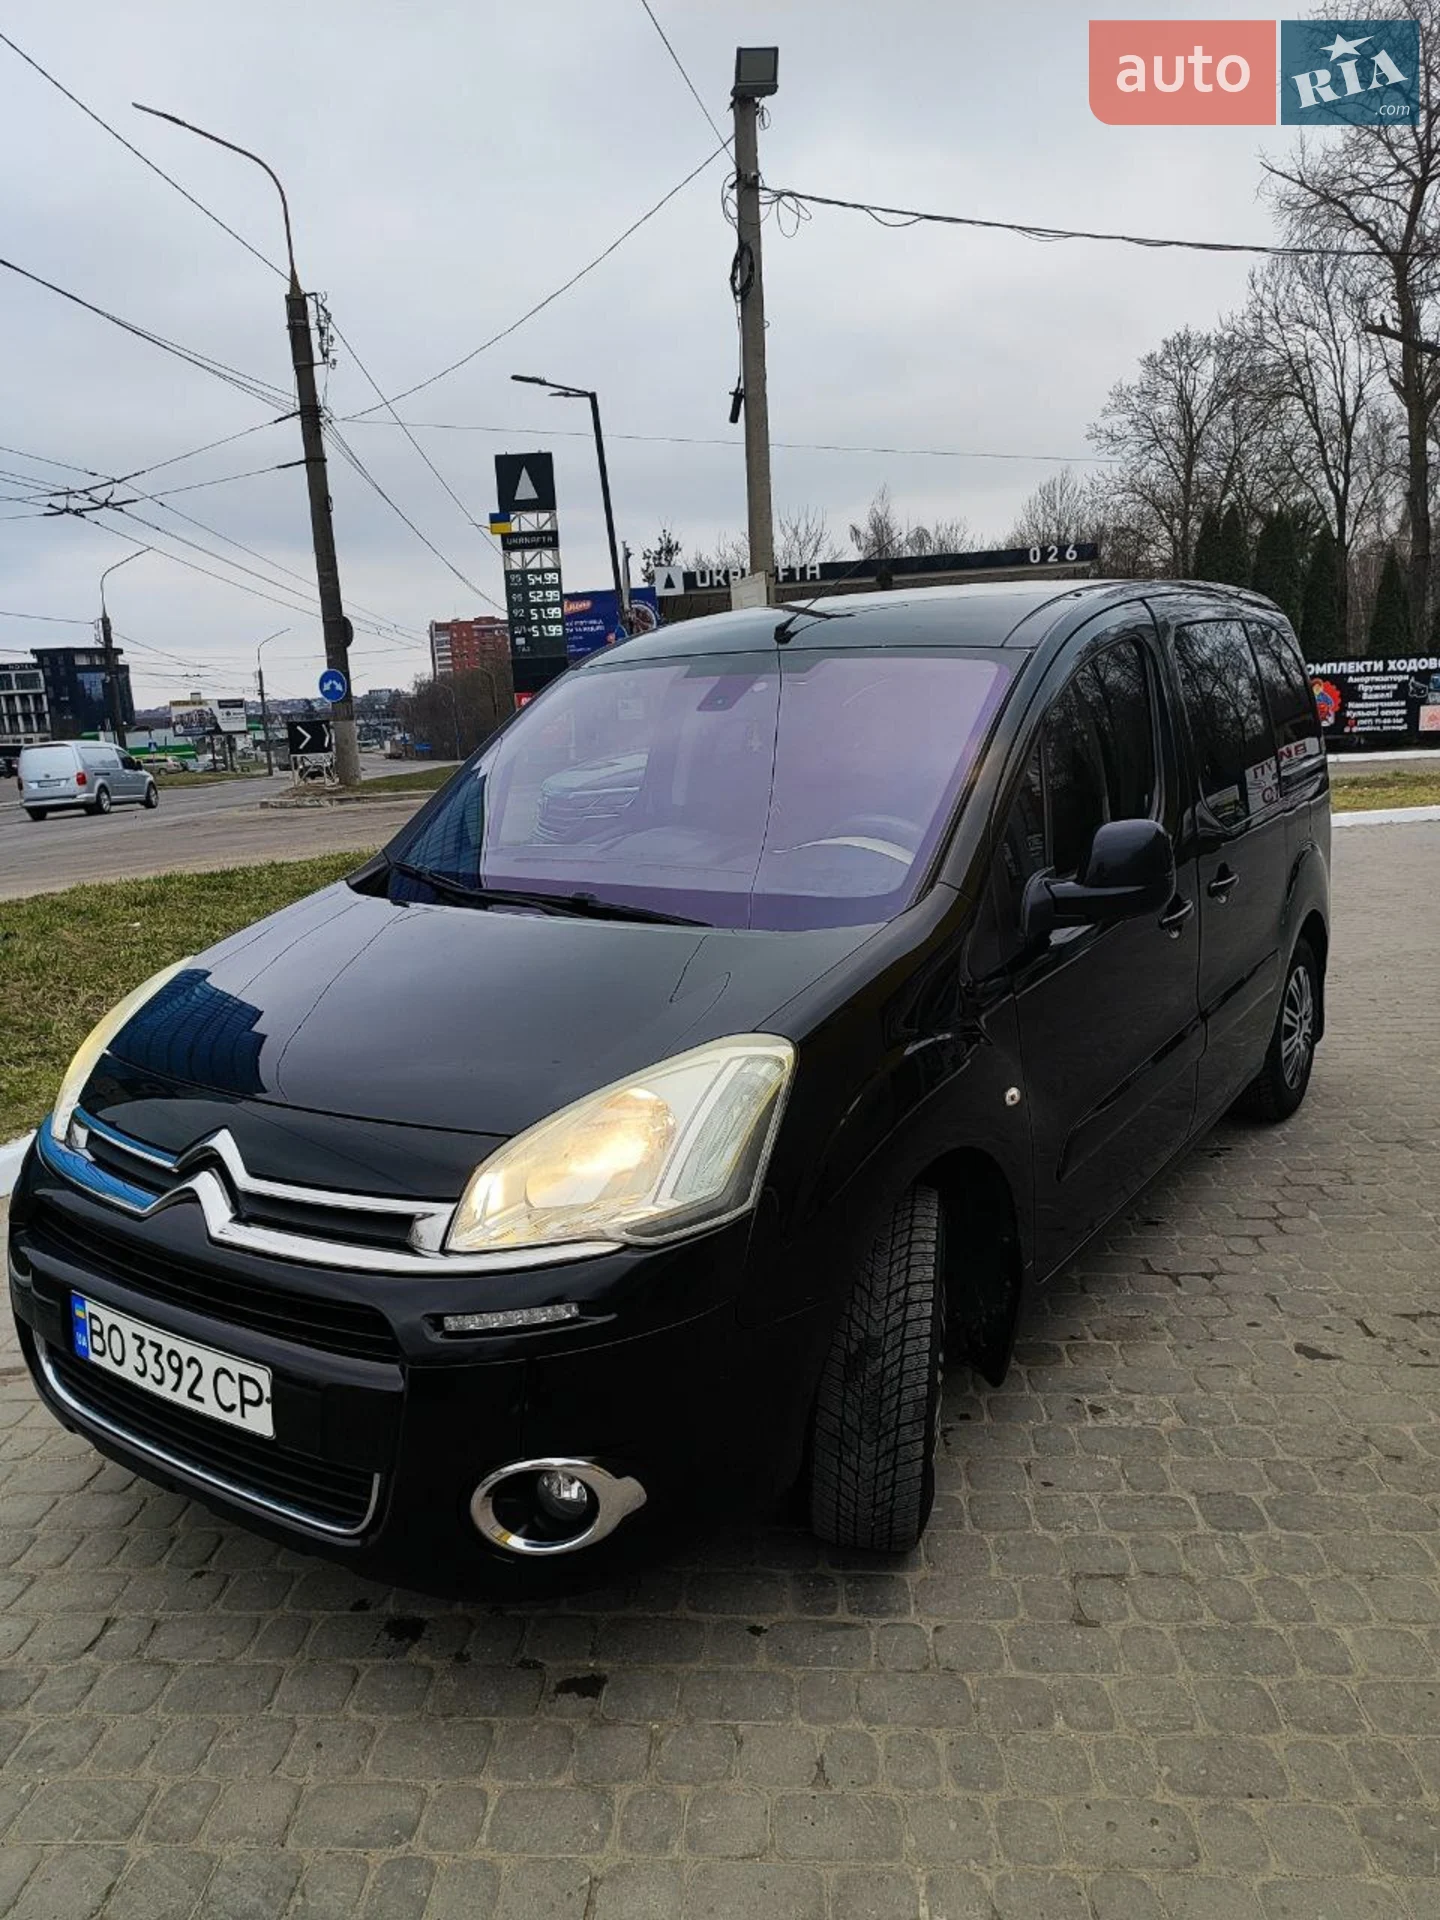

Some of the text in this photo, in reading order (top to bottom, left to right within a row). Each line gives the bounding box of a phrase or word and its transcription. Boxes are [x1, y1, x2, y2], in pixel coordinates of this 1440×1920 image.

[696, 563, 821, 588] UKRFTA
[512, 608, 525, 618] 92
[1306, 657, 1440, 676] ОМПЛЕКТИ ХОДОВ
[75, 1331, 88, 1348] UA
[88, 1312, 264, 1419] BO 3392 CP
